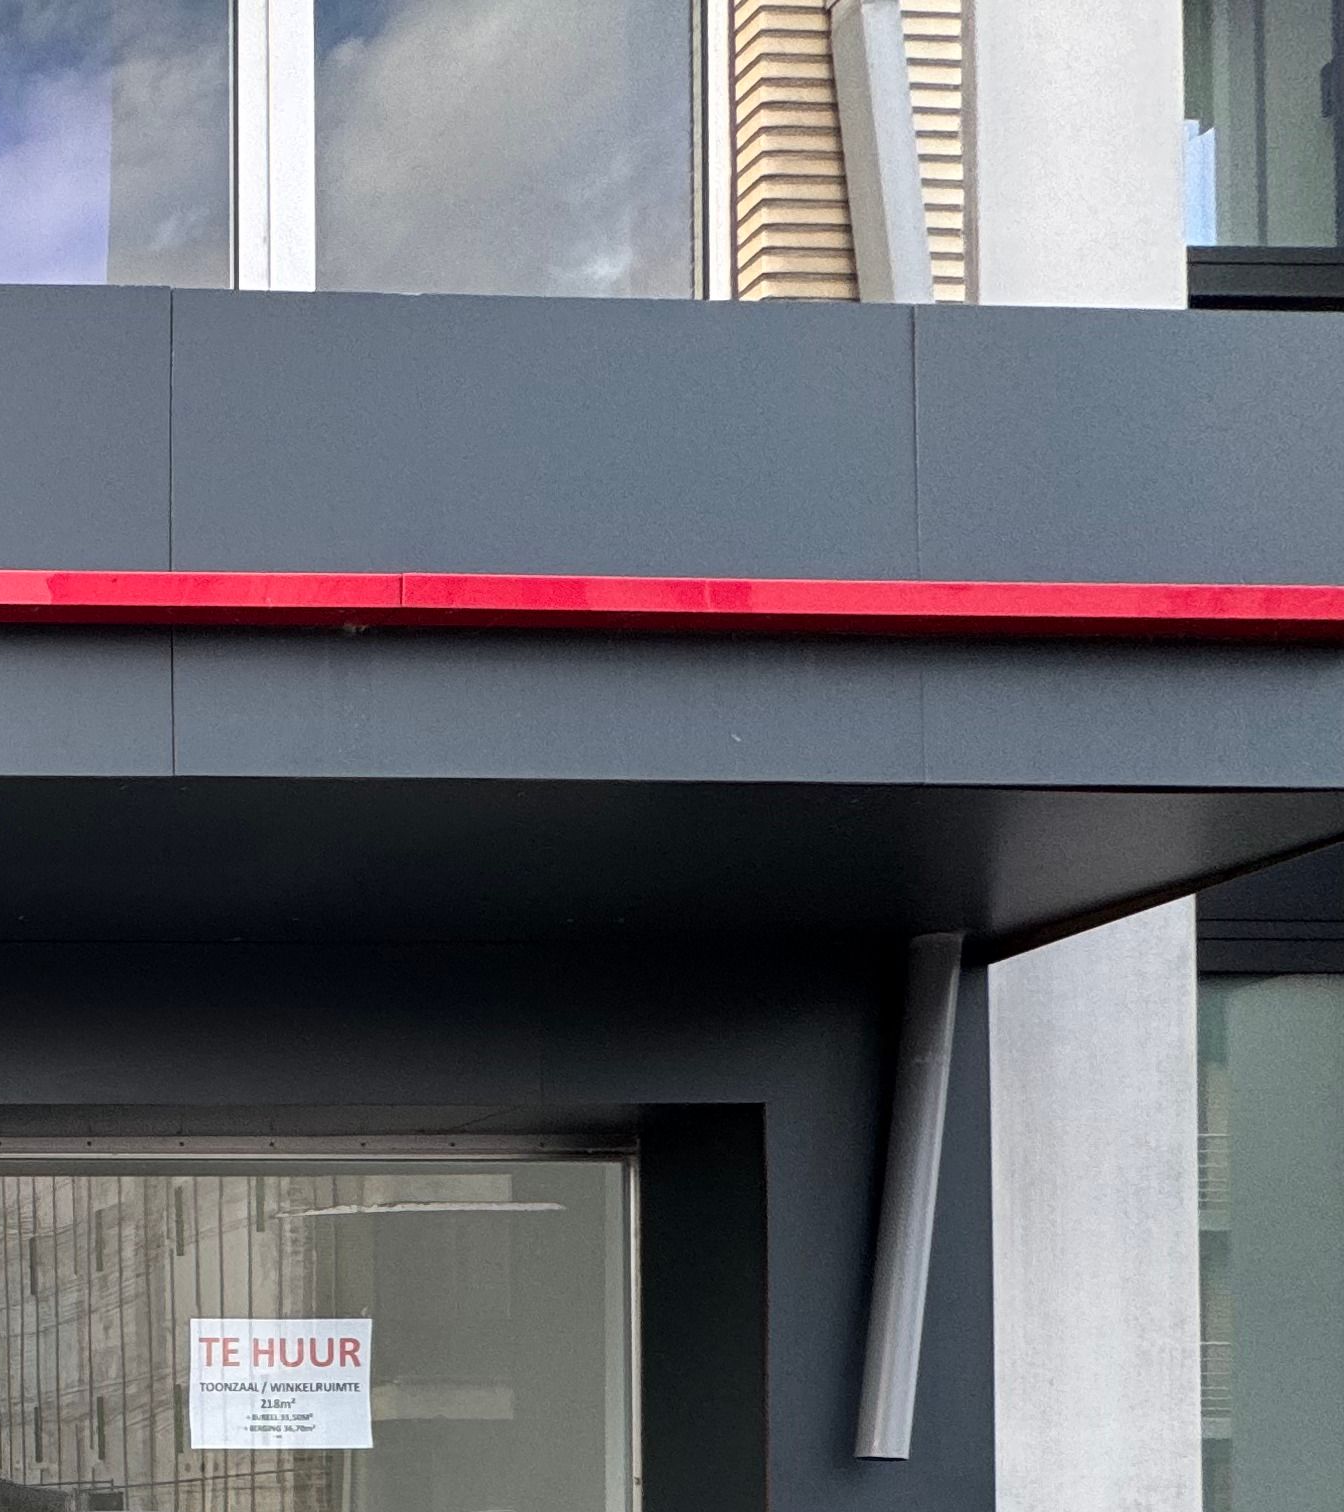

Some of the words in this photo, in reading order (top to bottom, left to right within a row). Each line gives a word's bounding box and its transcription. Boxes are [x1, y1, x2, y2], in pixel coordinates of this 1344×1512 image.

[199, 1337, 240, 1367] TE
[253, 1337, 361, 1367] HUUR
[200, 1382, 259, 1392] TOONZAAL
[270, 1382, 361, 1392] WINKELRUIMTE
